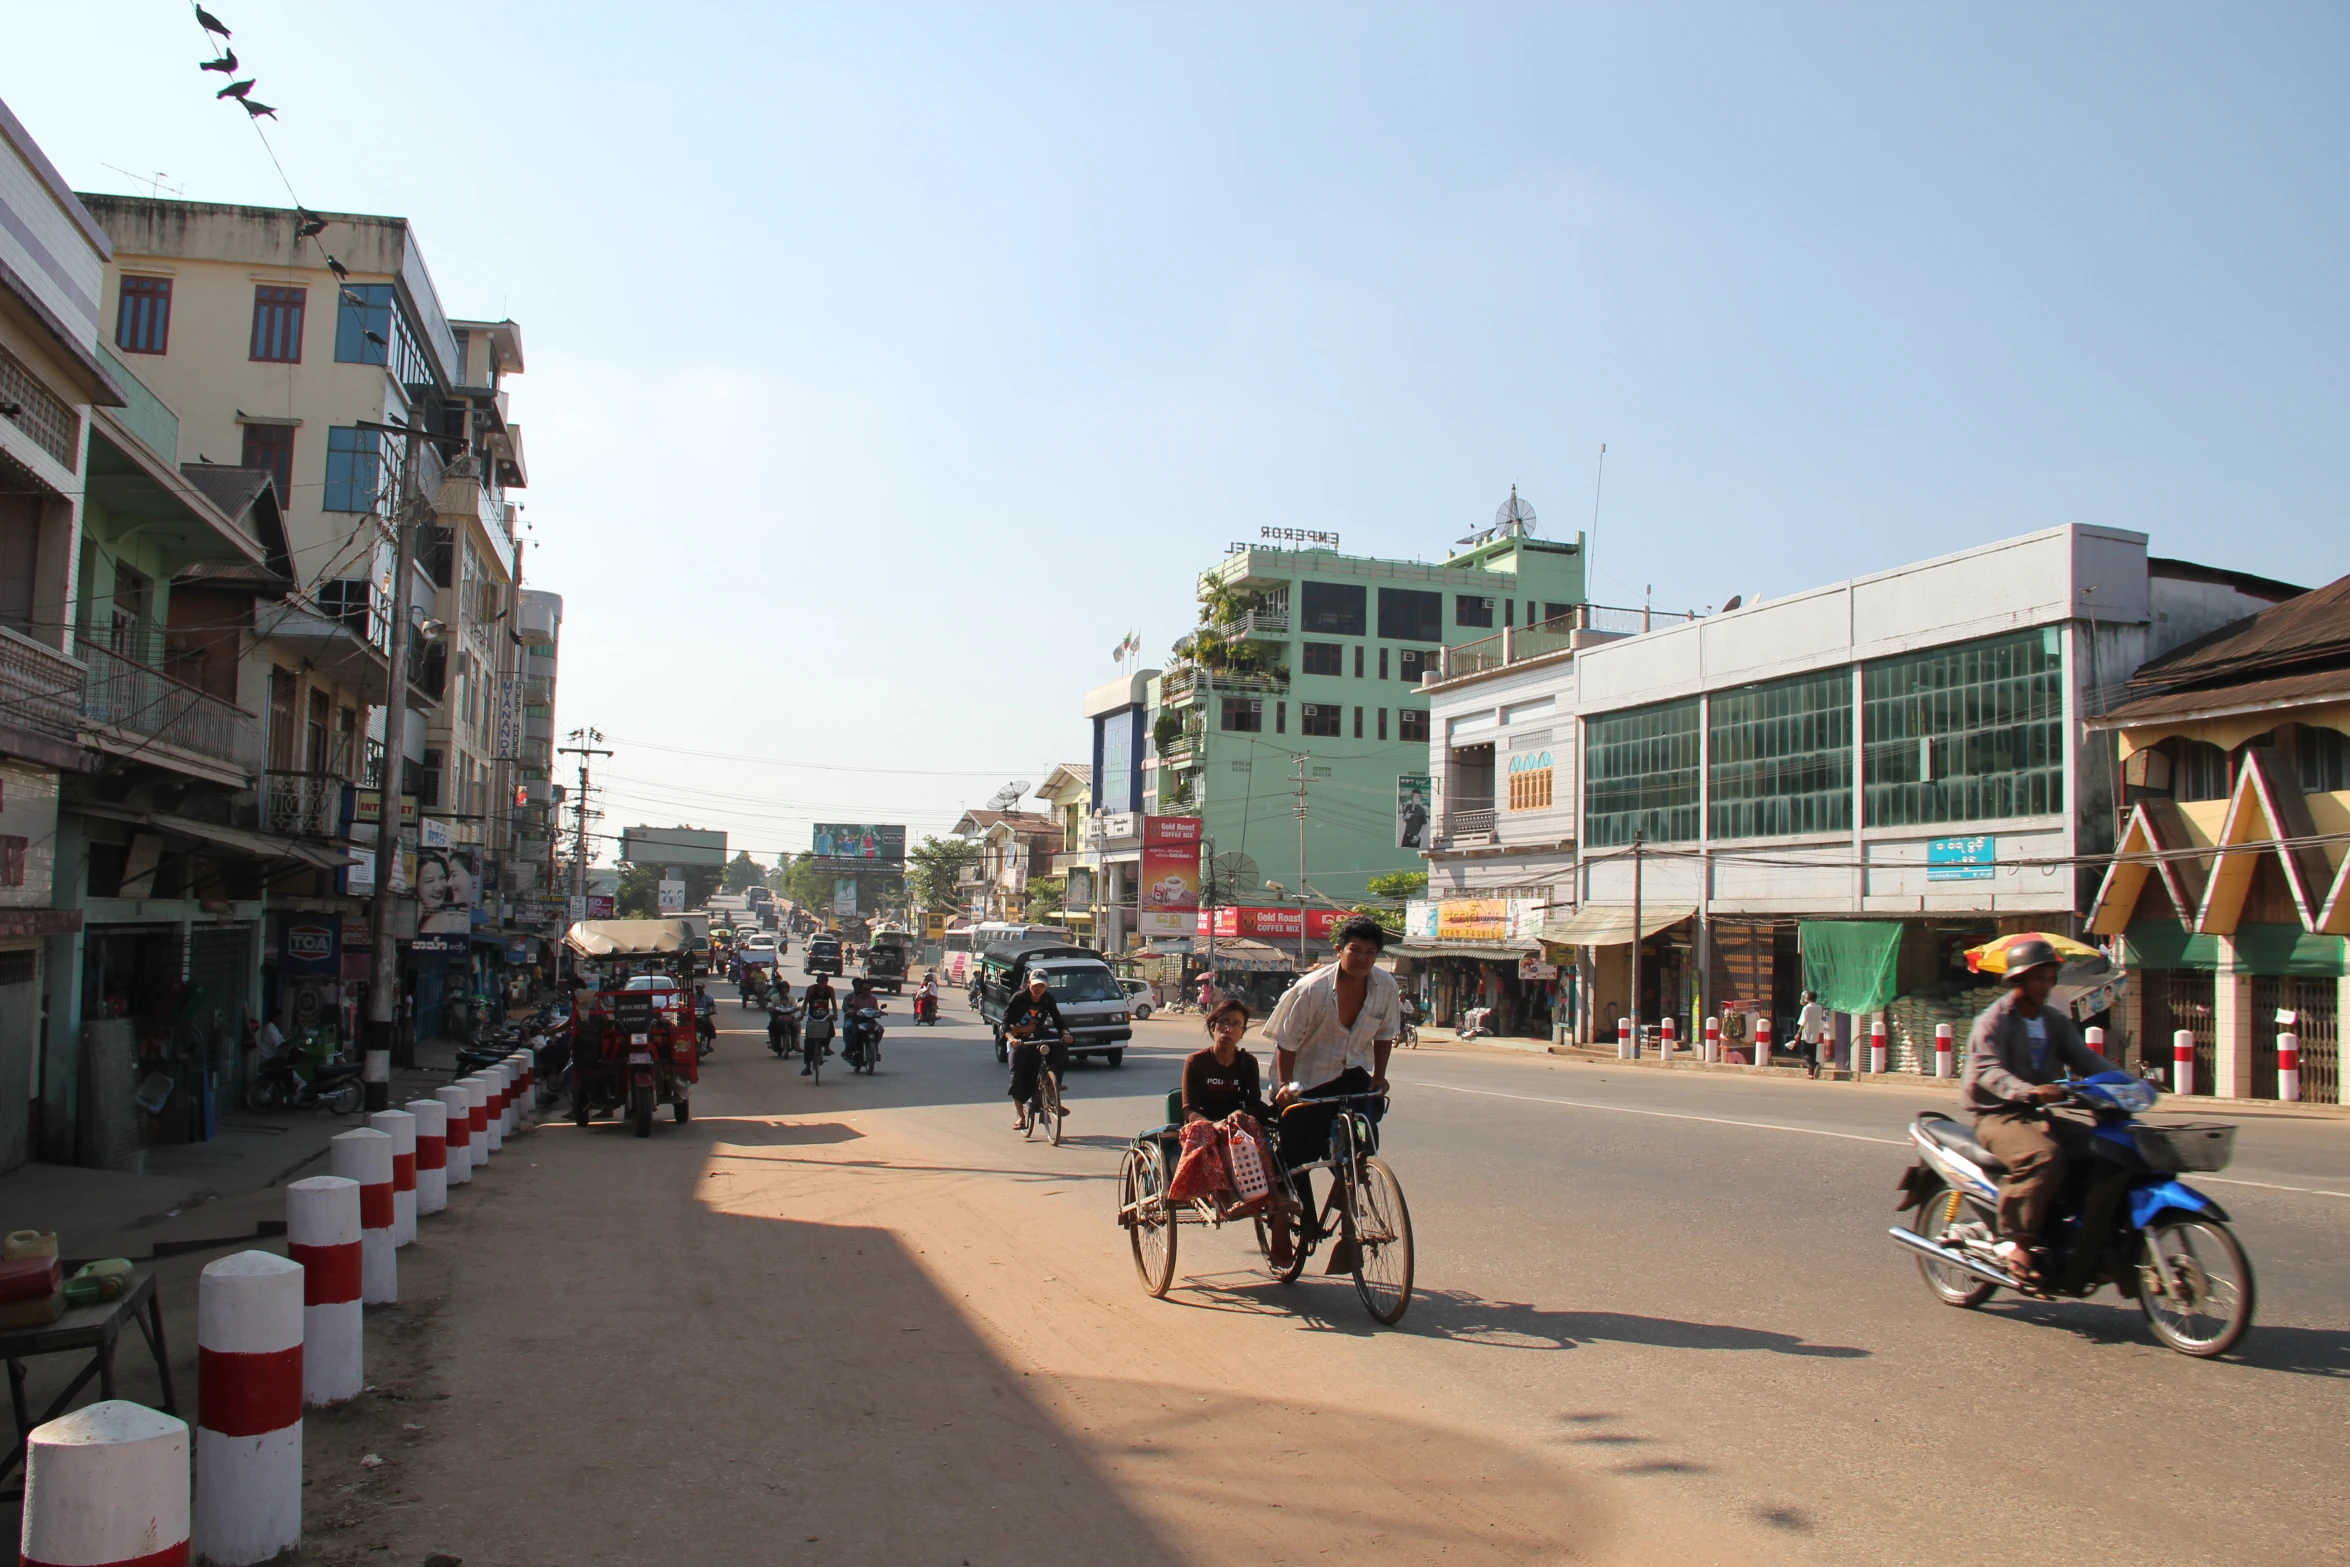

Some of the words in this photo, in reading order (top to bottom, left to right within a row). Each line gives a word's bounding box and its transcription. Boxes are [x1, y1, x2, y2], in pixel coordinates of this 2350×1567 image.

[514, 681, 522, 718] GUEST
[500, 681, 513, 758] MYANANDA
[511, 722, 520, 759] HOUSE
[360, 802, 414, 815] INTET
[1161, 822, 1175, 831] Gold
[1176, 823, 1195, 832] Roast
[1161, 831, 1182, 839] COFFEE
[1257, 912, 1276, 922] Gold
[1277, 913, 1302, 923] Roast
[1257, 924, 1284, 933] COFFEE
[1285, 925, 1300, 933] MIX
[291, 935, 328, 951] TOA
[1206, 1077, 1239, 1086] POLIE
